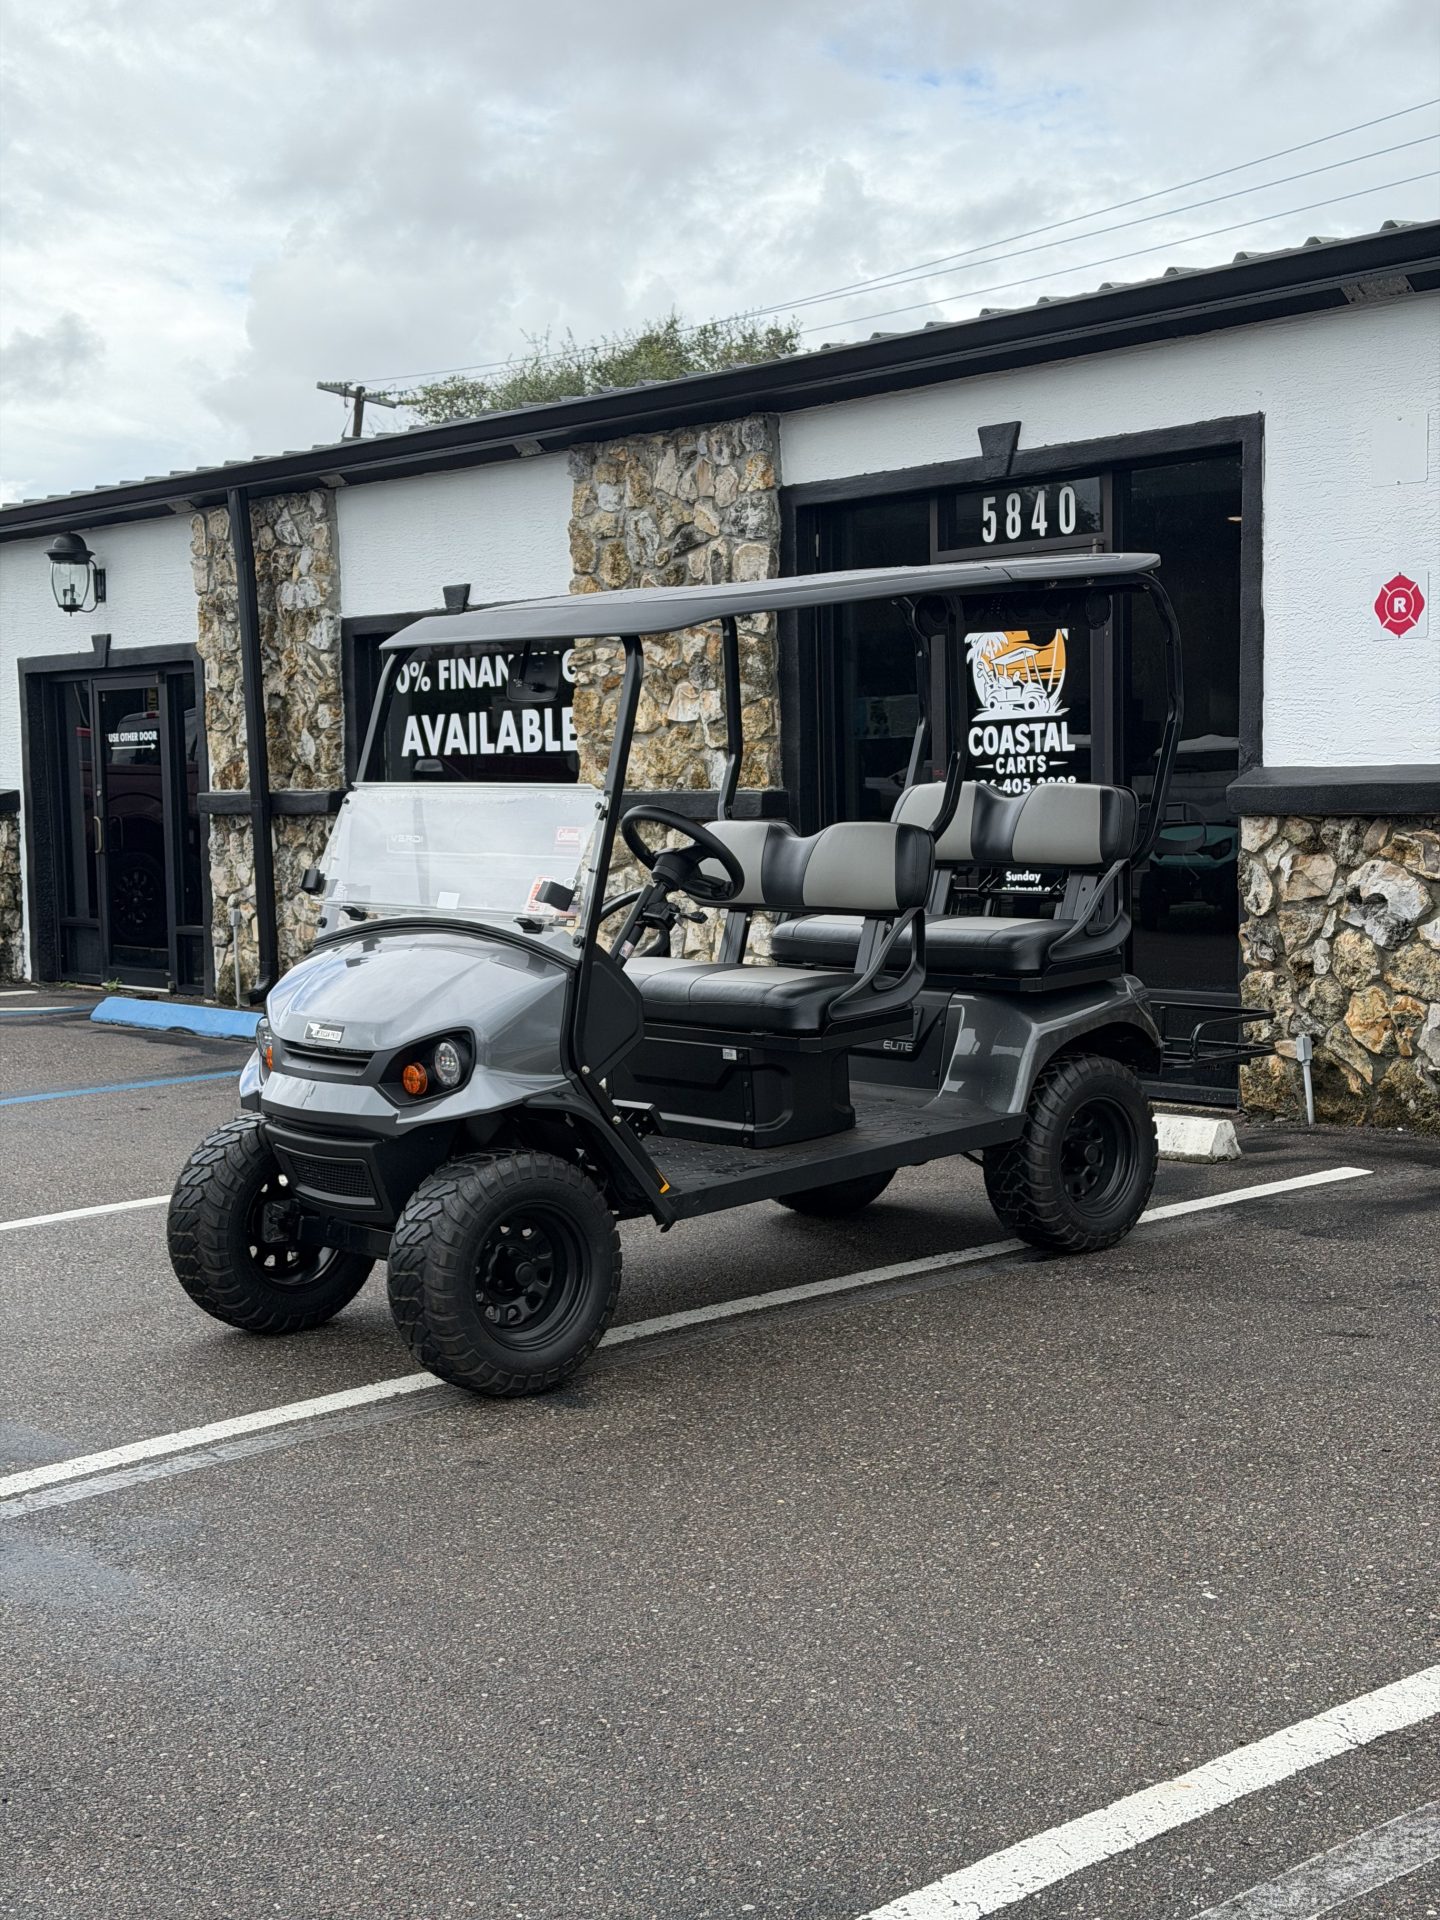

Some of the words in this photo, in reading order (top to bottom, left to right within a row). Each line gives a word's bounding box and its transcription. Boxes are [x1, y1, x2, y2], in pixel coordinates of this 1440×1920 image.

[982, 486, 1076, 543] 5840
[1393, 597, 1407, 613] R
[438, 648, 578, 691] FINANG
[108, 732, 119, 743] USE
[120, 731, 139, 742] OTHER
[140, 730, 157, 741] DOOR
[401, 706, 578, 757] AVAILABLE
[968, 721, 1076, 757] COASTAL
[995, 755, 1047, 775] CARTS
[1006, 870, 1041, 884] Sunday
[883, 1040, 913, 1052] ELITE
